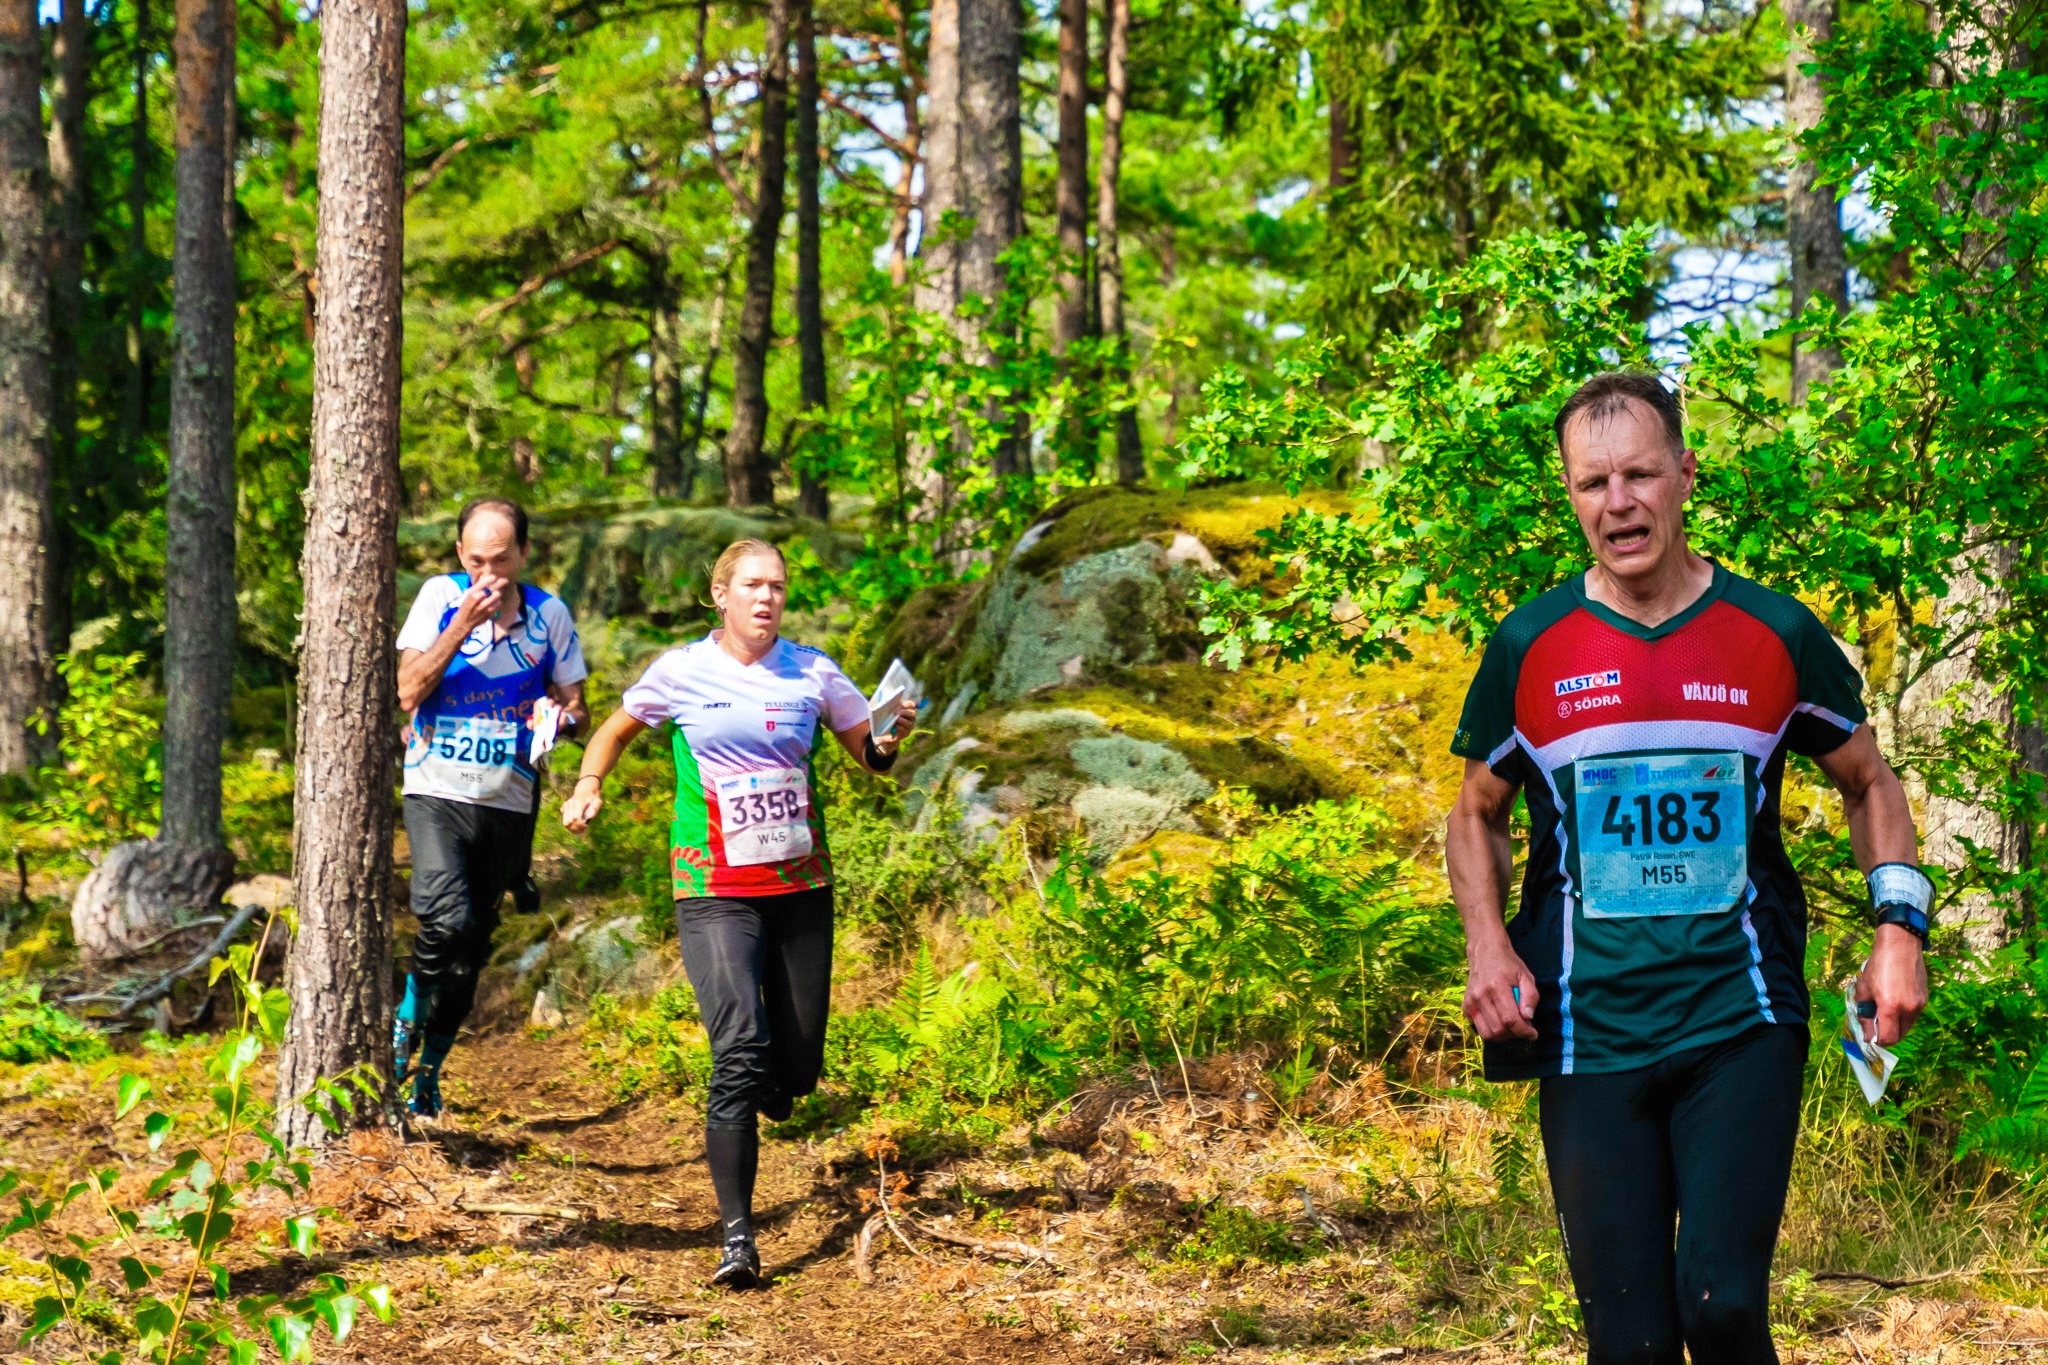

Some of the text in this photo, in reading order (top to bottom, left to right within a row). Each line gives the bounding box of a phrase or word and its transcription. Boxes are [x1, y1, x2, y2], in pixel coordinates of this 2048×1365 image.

[1557, 672, 1619, 695] ALSTOM
[463, 688, 505, 704] days
[1574, 694, 1622, 712] SÖDRA
[1682, 682, 1749, 706] VÄXJÖ OK
[440, 734, 507, 766] 5208
[460, 771, 483, 784] M55
[1582, 768, 1617, 781] WMOC
[1650, 769, 1691, 780] TURKU
[729, 789, 800, 825] 3358
[1601, 791, 1722, 847] 4183
[757, 831, 786, 845] W45
[1630, 853, 1652, 861] Patrik
[1679, 850, 1696, 859] SWE
[1641, 864, 1687, 886] M55
